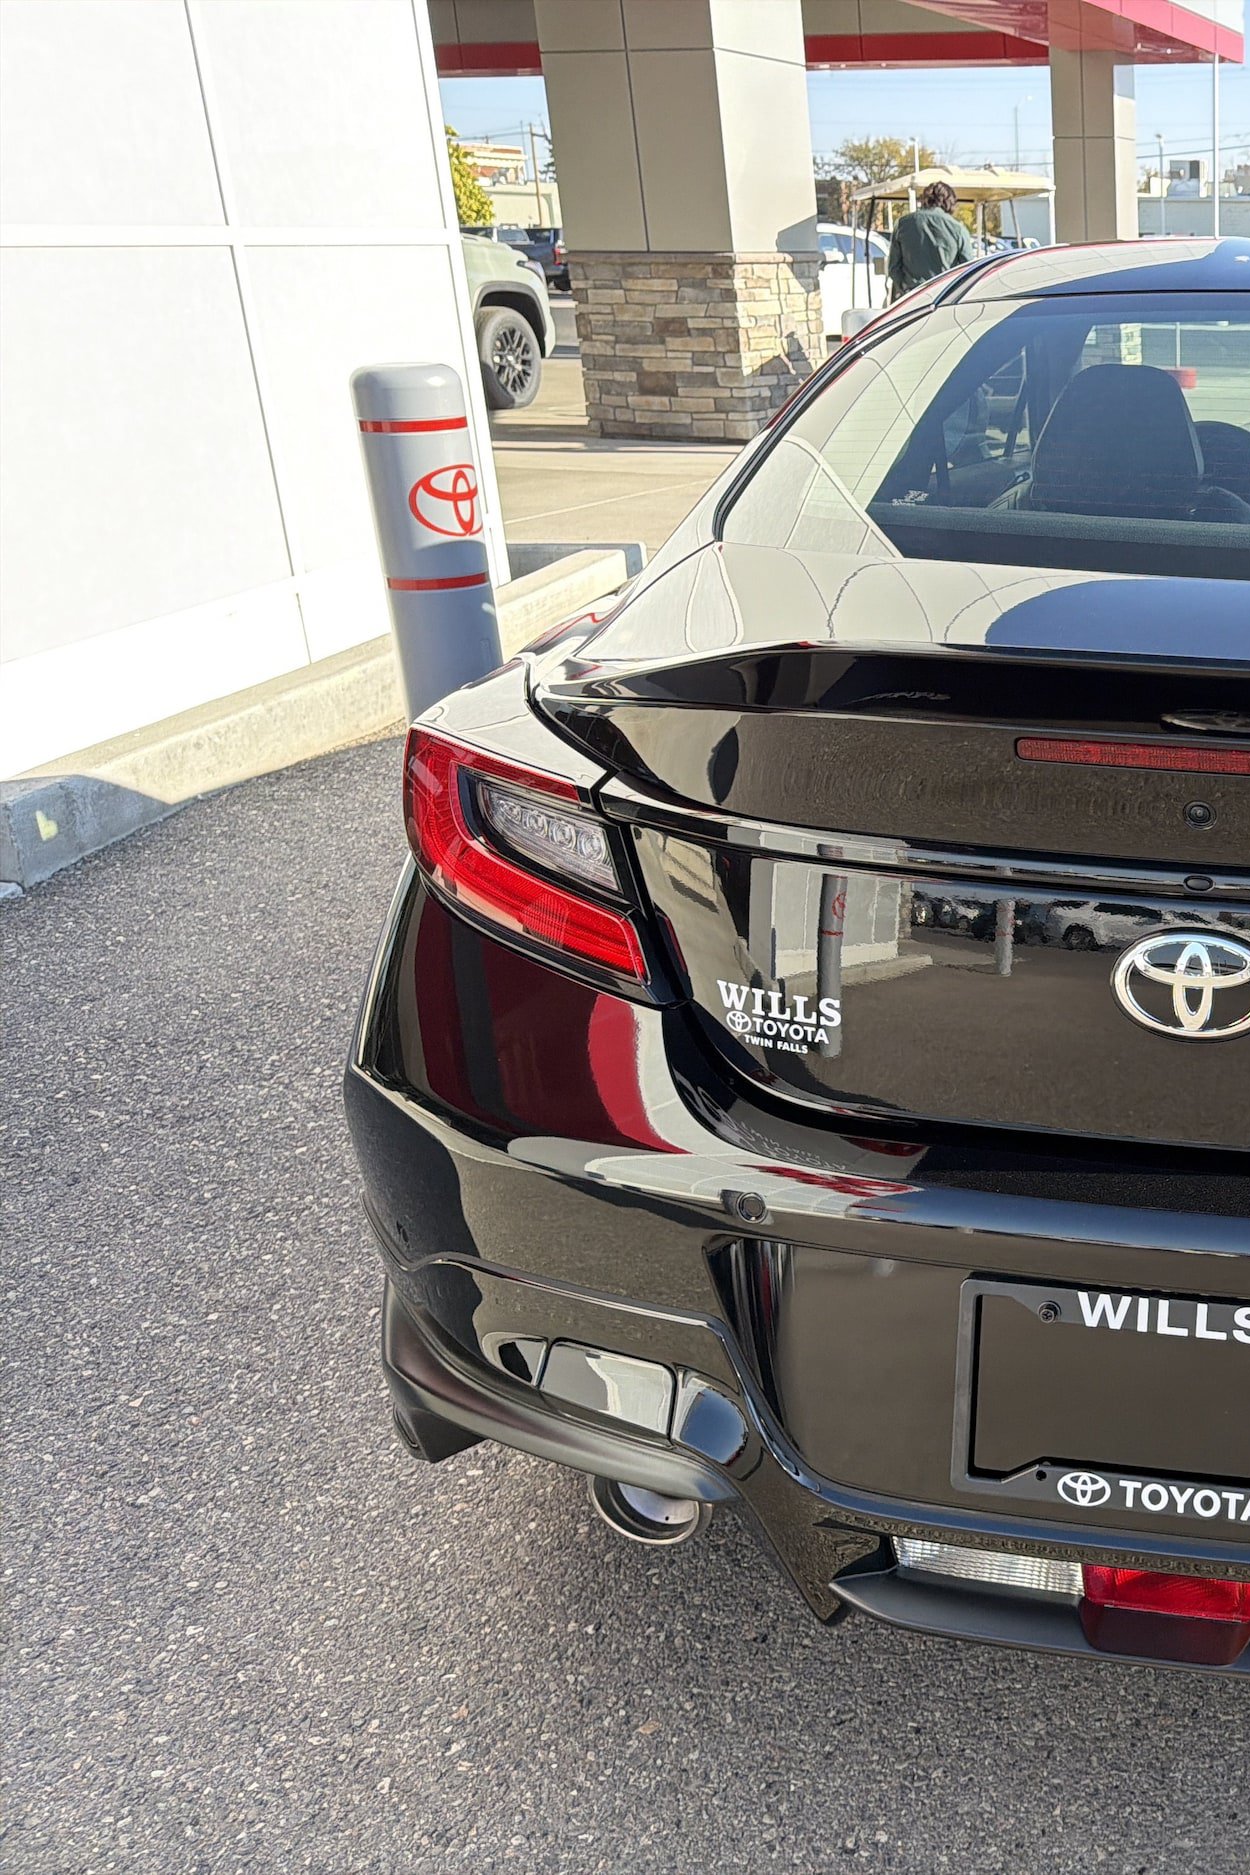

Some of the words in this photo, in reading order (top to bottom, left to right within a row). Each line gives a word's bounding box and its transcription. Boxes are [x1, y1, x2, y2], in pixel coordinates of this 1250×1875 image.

[716, 979, 842, 1027] WILLS
[744, 1034, 773, 1049] TWIN
[776, 1040, 808, 1054] FALLS
[752, 1017, 830, 1044] TOYOTA
